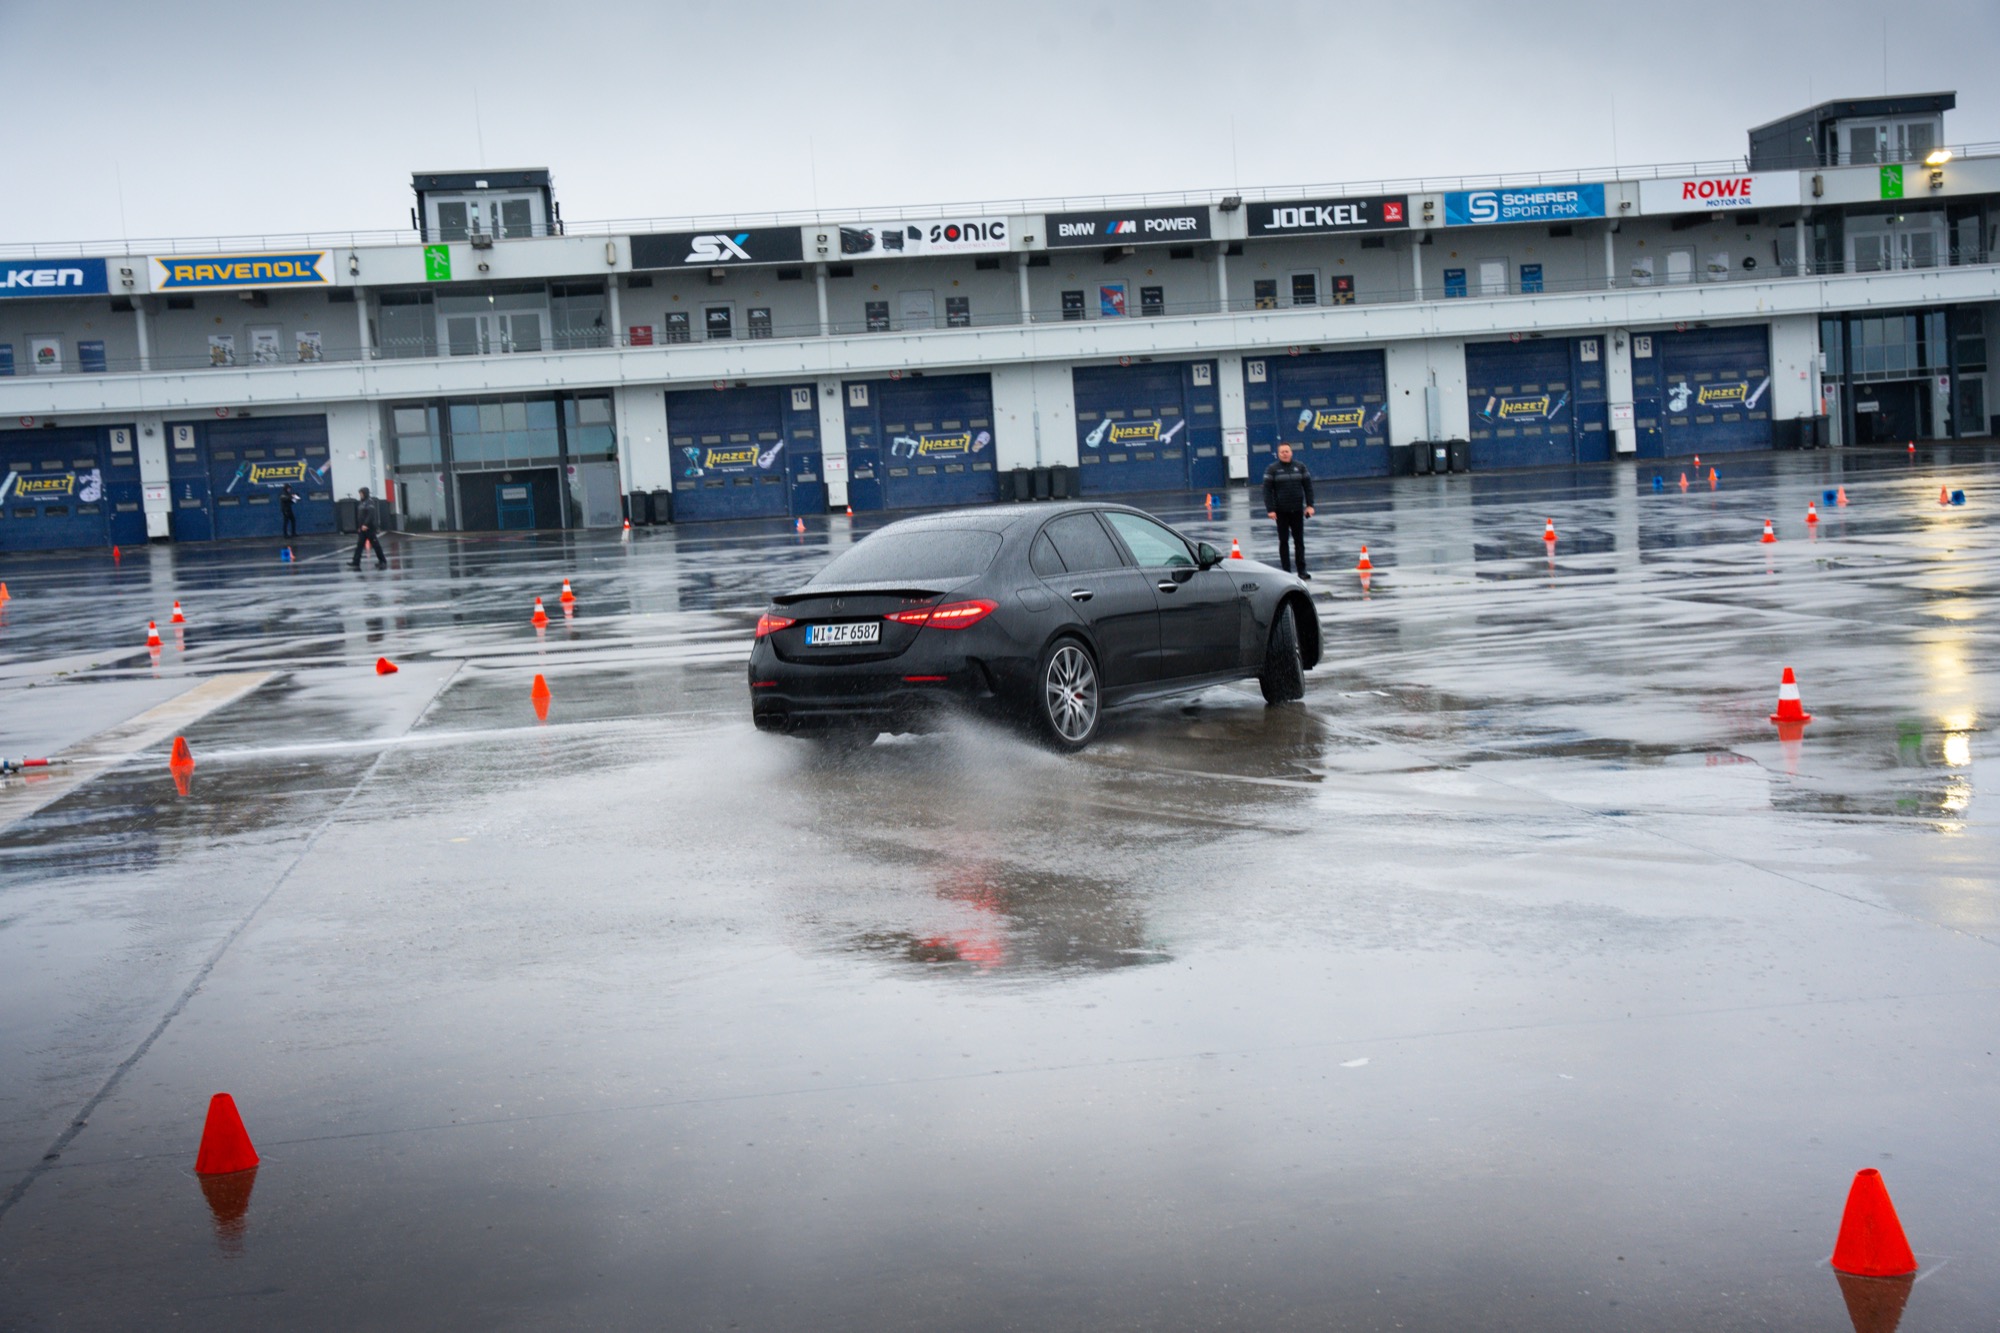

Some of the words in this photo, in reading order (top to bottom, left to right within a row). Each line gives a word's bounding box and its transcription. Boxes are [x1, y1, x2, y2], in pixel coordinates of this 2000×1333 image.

[1681, 178, 1752, 200] ROWE
[1501, 191, 1578, 206] SCHERER
[1706, 198, 1737, 207] MOTOR
[1264, 204, 1368, 229] JOCKEL
[1502, 205, 1549, 218] SPORT
[1551, 203, 1579, 216] PHX
[930, 221, 1005, 244] SONIC
[1058, 222, 1096, 237] BMW
[1144, 217, 1197, 232] POWER
[684, 233, 752, 263] SX
[174, 261, 311, 282] RAVENOL
[1583, 342, 1596, 354] 14
[1636, 339, 1650, 351] 15
[1195, 366, 1209, 379] 12
[1250, 363, 1264, 376] 13
[794, 389, 809, 403] 10
[853, 386, 865, 400] 11
[1702, 387, 1743, 401] HAZET
[1504, 400, 1544, 414] HAZET
[1319, 412, 1361, 426] HAZET
[116, 431, 125, 444] 8
[179, 427, 188, 441] 9
[1114, 425, 1156, 439] HAZET
[924, 437, 966, 451] HAZET
[710, 450, 754, 465] HAZET
[255, 465, 301, 479] HAZET
[21, 478, 69, 493] HAZET
[813, 627, 826, 642] WI
[833, 626, 848, 641] ZF
[850, 624, 878, 639] 6587
